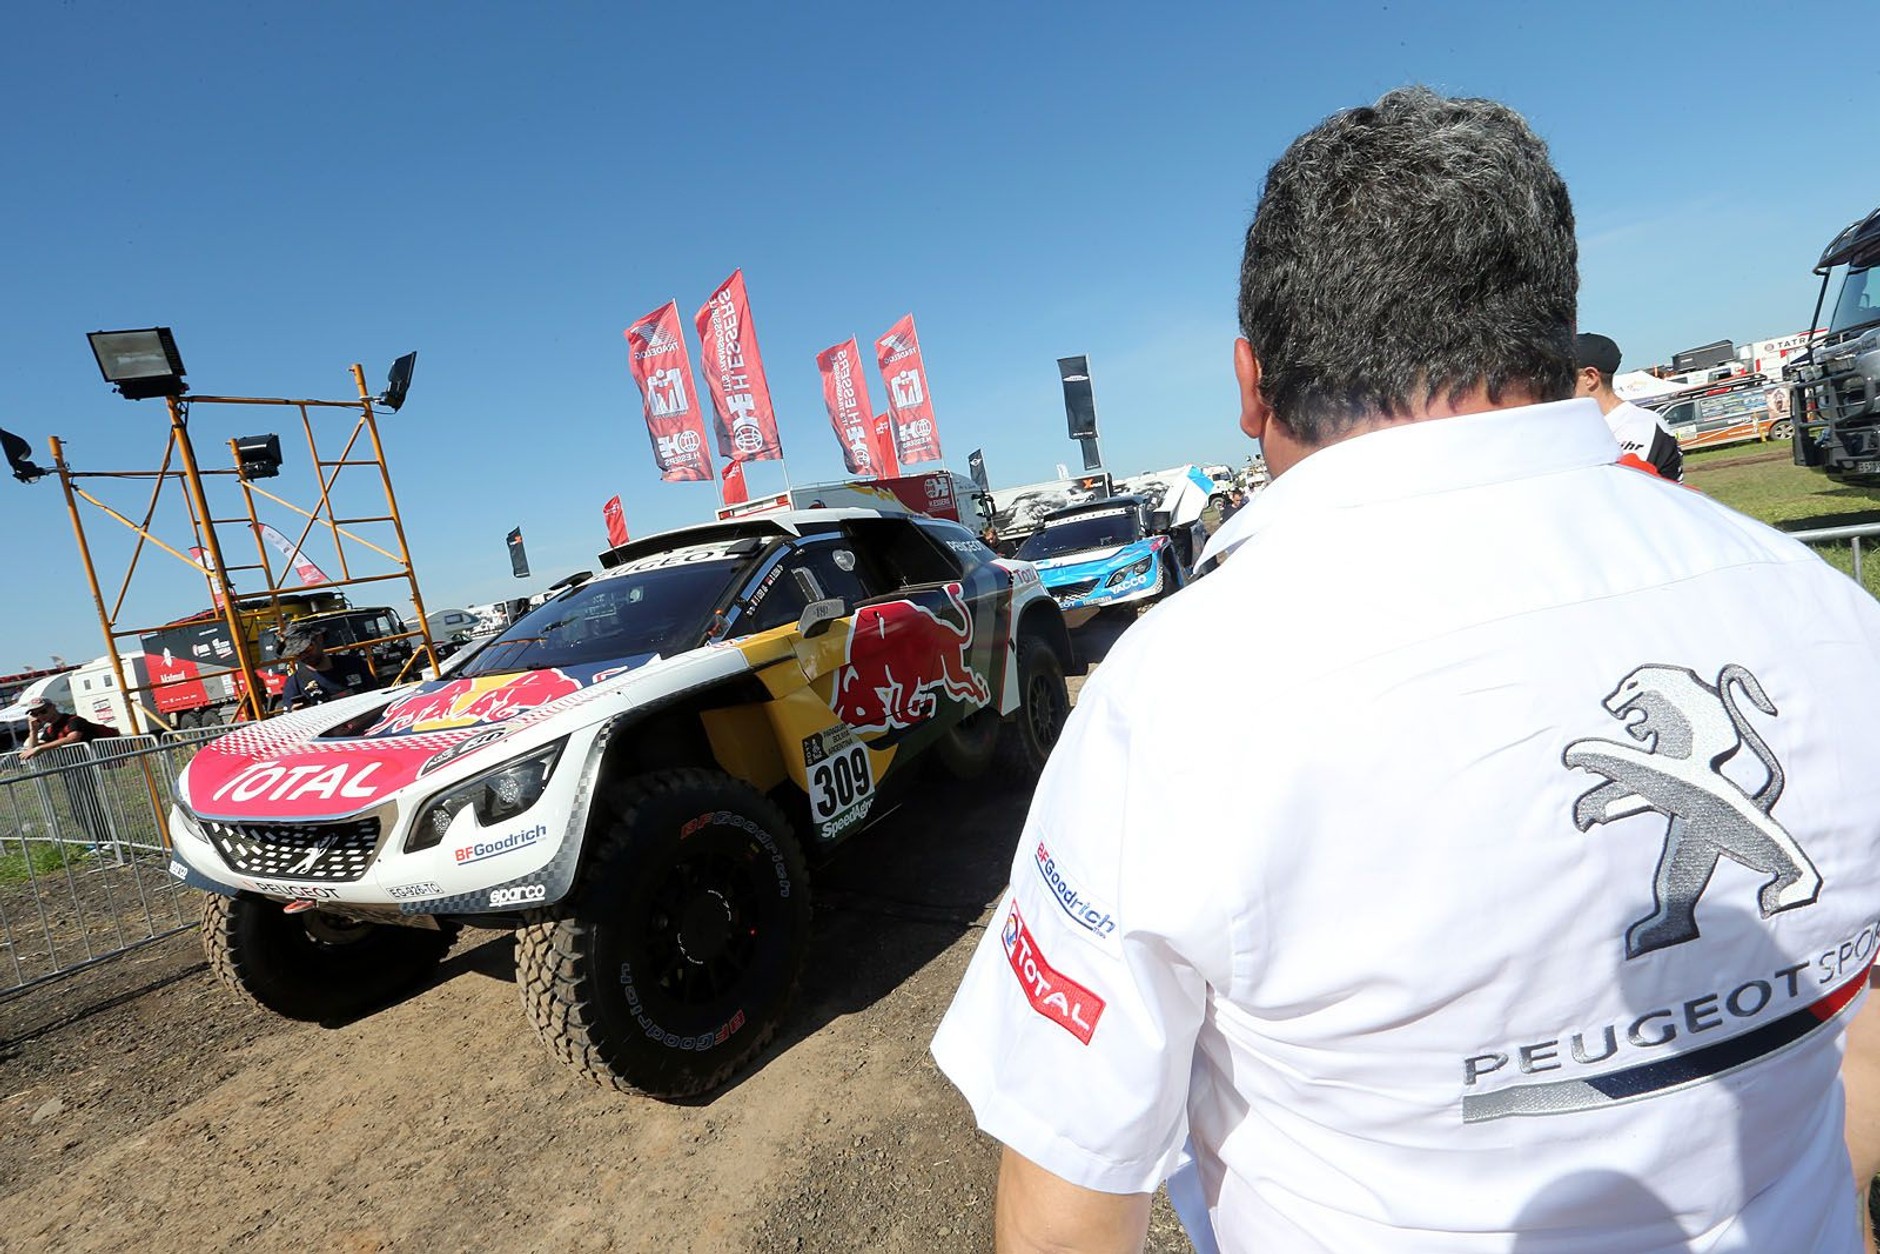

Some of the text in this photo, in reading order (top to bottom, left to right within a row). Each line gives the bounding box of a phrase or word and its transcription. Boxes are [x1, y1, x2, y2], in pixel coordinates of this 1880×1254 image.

[1777, 337, 1810, 348] TATR
[1107, 575, 1147, 594] YACCO
[212, 760, 383, 802] TOTAL
[814, 747, 870, 818] 309
[454, 824, 548, 862] BFGoodrich
[680, 811, 792, 898] BFGoodrich
[256, 882, 342, 899] PEUGEOT
[490, 884, 546, 907] sparco
[1036, 842, 1117, 935] BFGoodrich
[620, 962, 746, 1052] BFGoodrich
[1017, 935, 1091, 1032] TOTAL
[1462, 960, 1810, 1087] PEUGEOT
